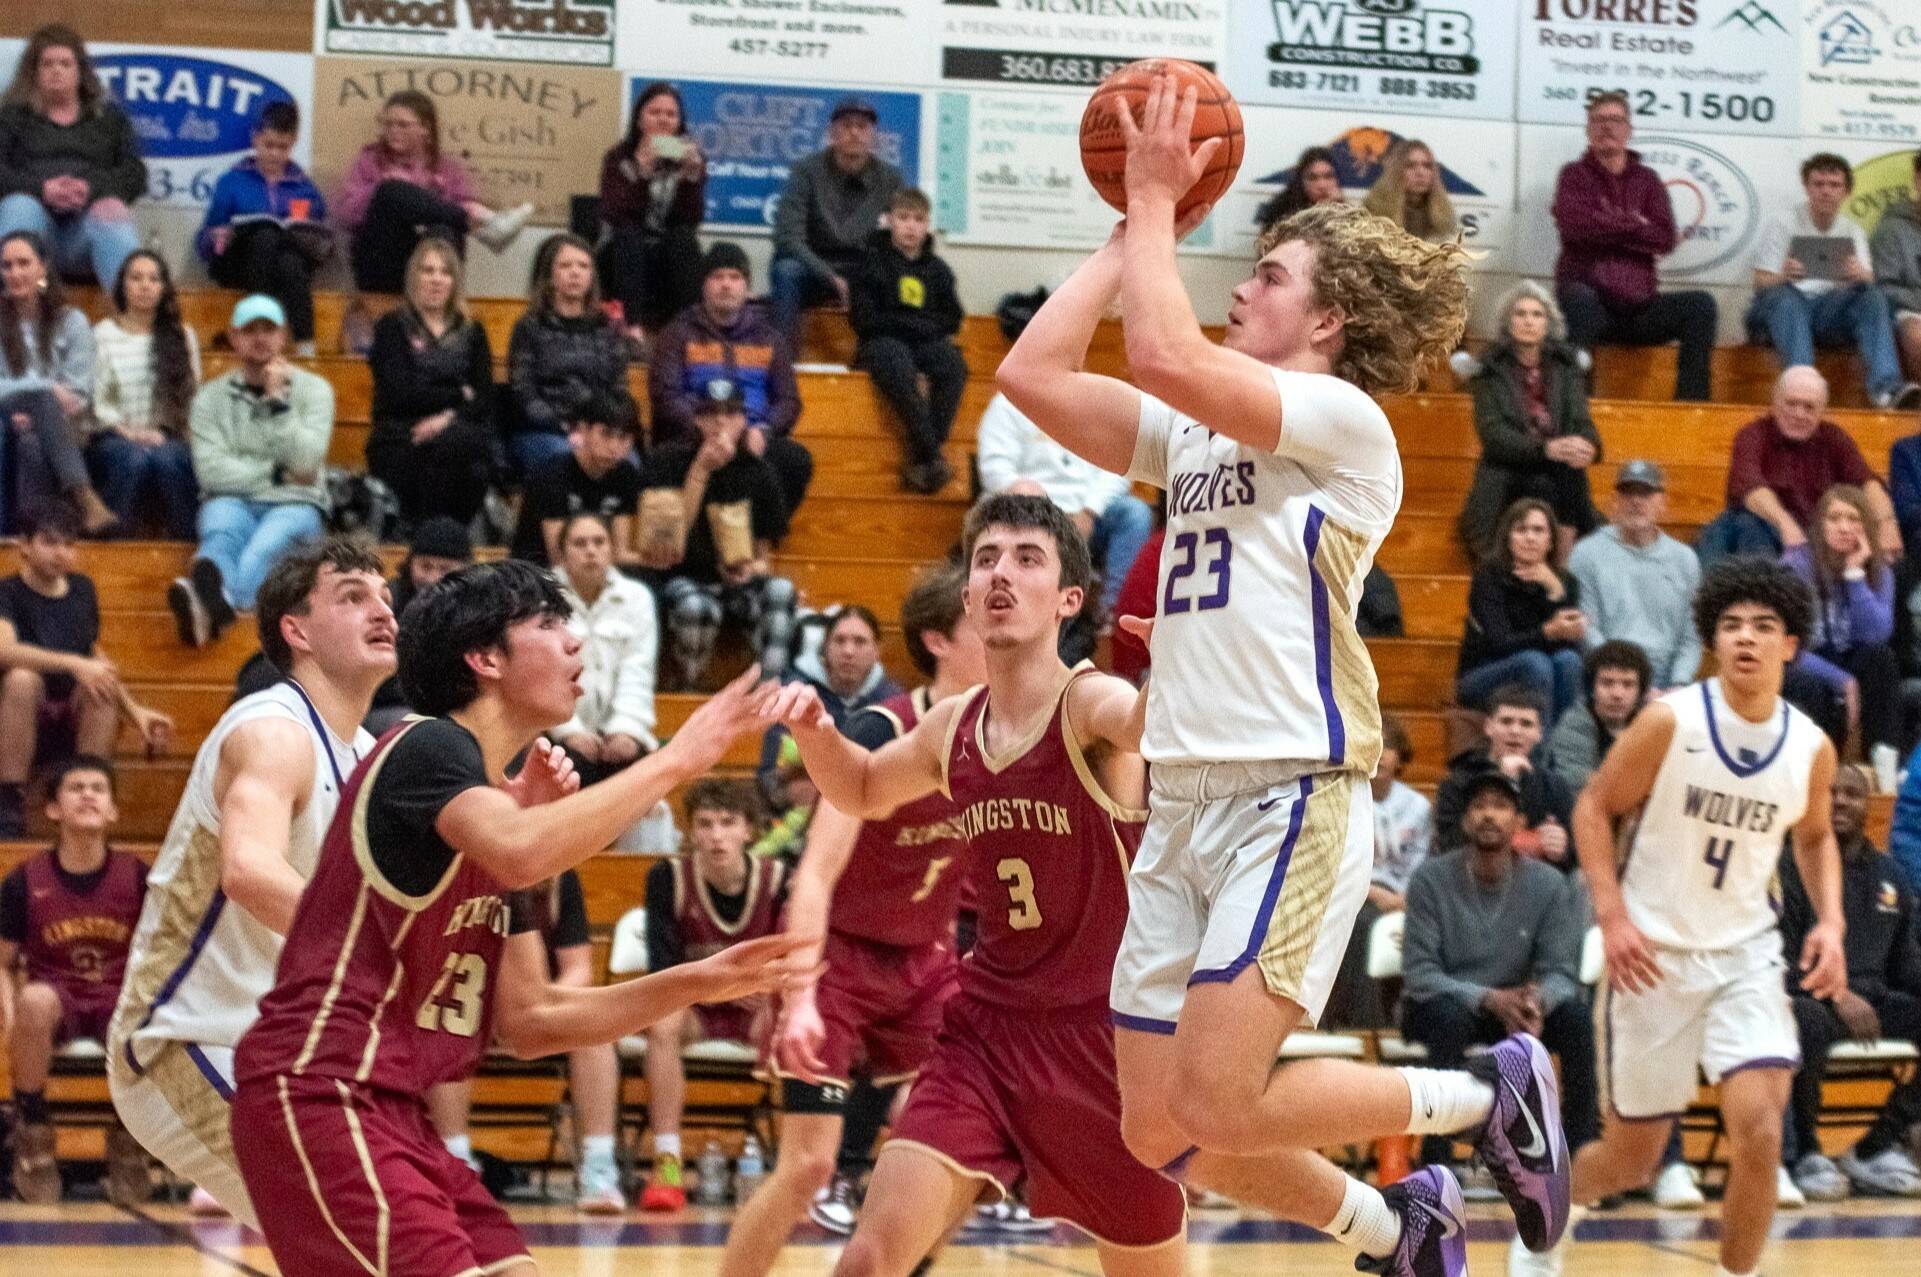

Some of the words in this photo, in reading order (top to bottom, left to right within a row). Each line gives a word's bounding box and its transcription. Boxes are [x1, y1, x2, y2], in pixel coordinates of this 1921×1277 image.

[689, 12, 777, 31] Storefront
[784, 20, 815, 33] and
[960, 20, 1052, 39] PERSONAL
[1058, 27, 1121, 43] INJURY
[1127, 29, 1165, 44] LAW
[1170, 31, 1214, 47] FIRM
[1271, 0, 1476, 56] WEBB
[1534, 0, 1699, 27] TORRES
[728, 37, 831, 58] 457-5277
[1281, 48, 1431, 69] CONSTRUCTION
[1538, 27, 1601, 49] Real
[1610, 32, 1694, 55] Estate
[338, 67, 597, 119] ATTORNEY
[1637, 63, 1665, 79] the
[1584, 85, 1775, 123] 52-1500
[1168, 460, 1256, 518] WOLVES
[1164, 527, 1232, 616] 23
[1683, 783, 1779, 833] WOLVES
[1703, 835, 1735, 890] 4
[996, 857, 1043, 931] 3
[415, 951, 487, 1038] 23
